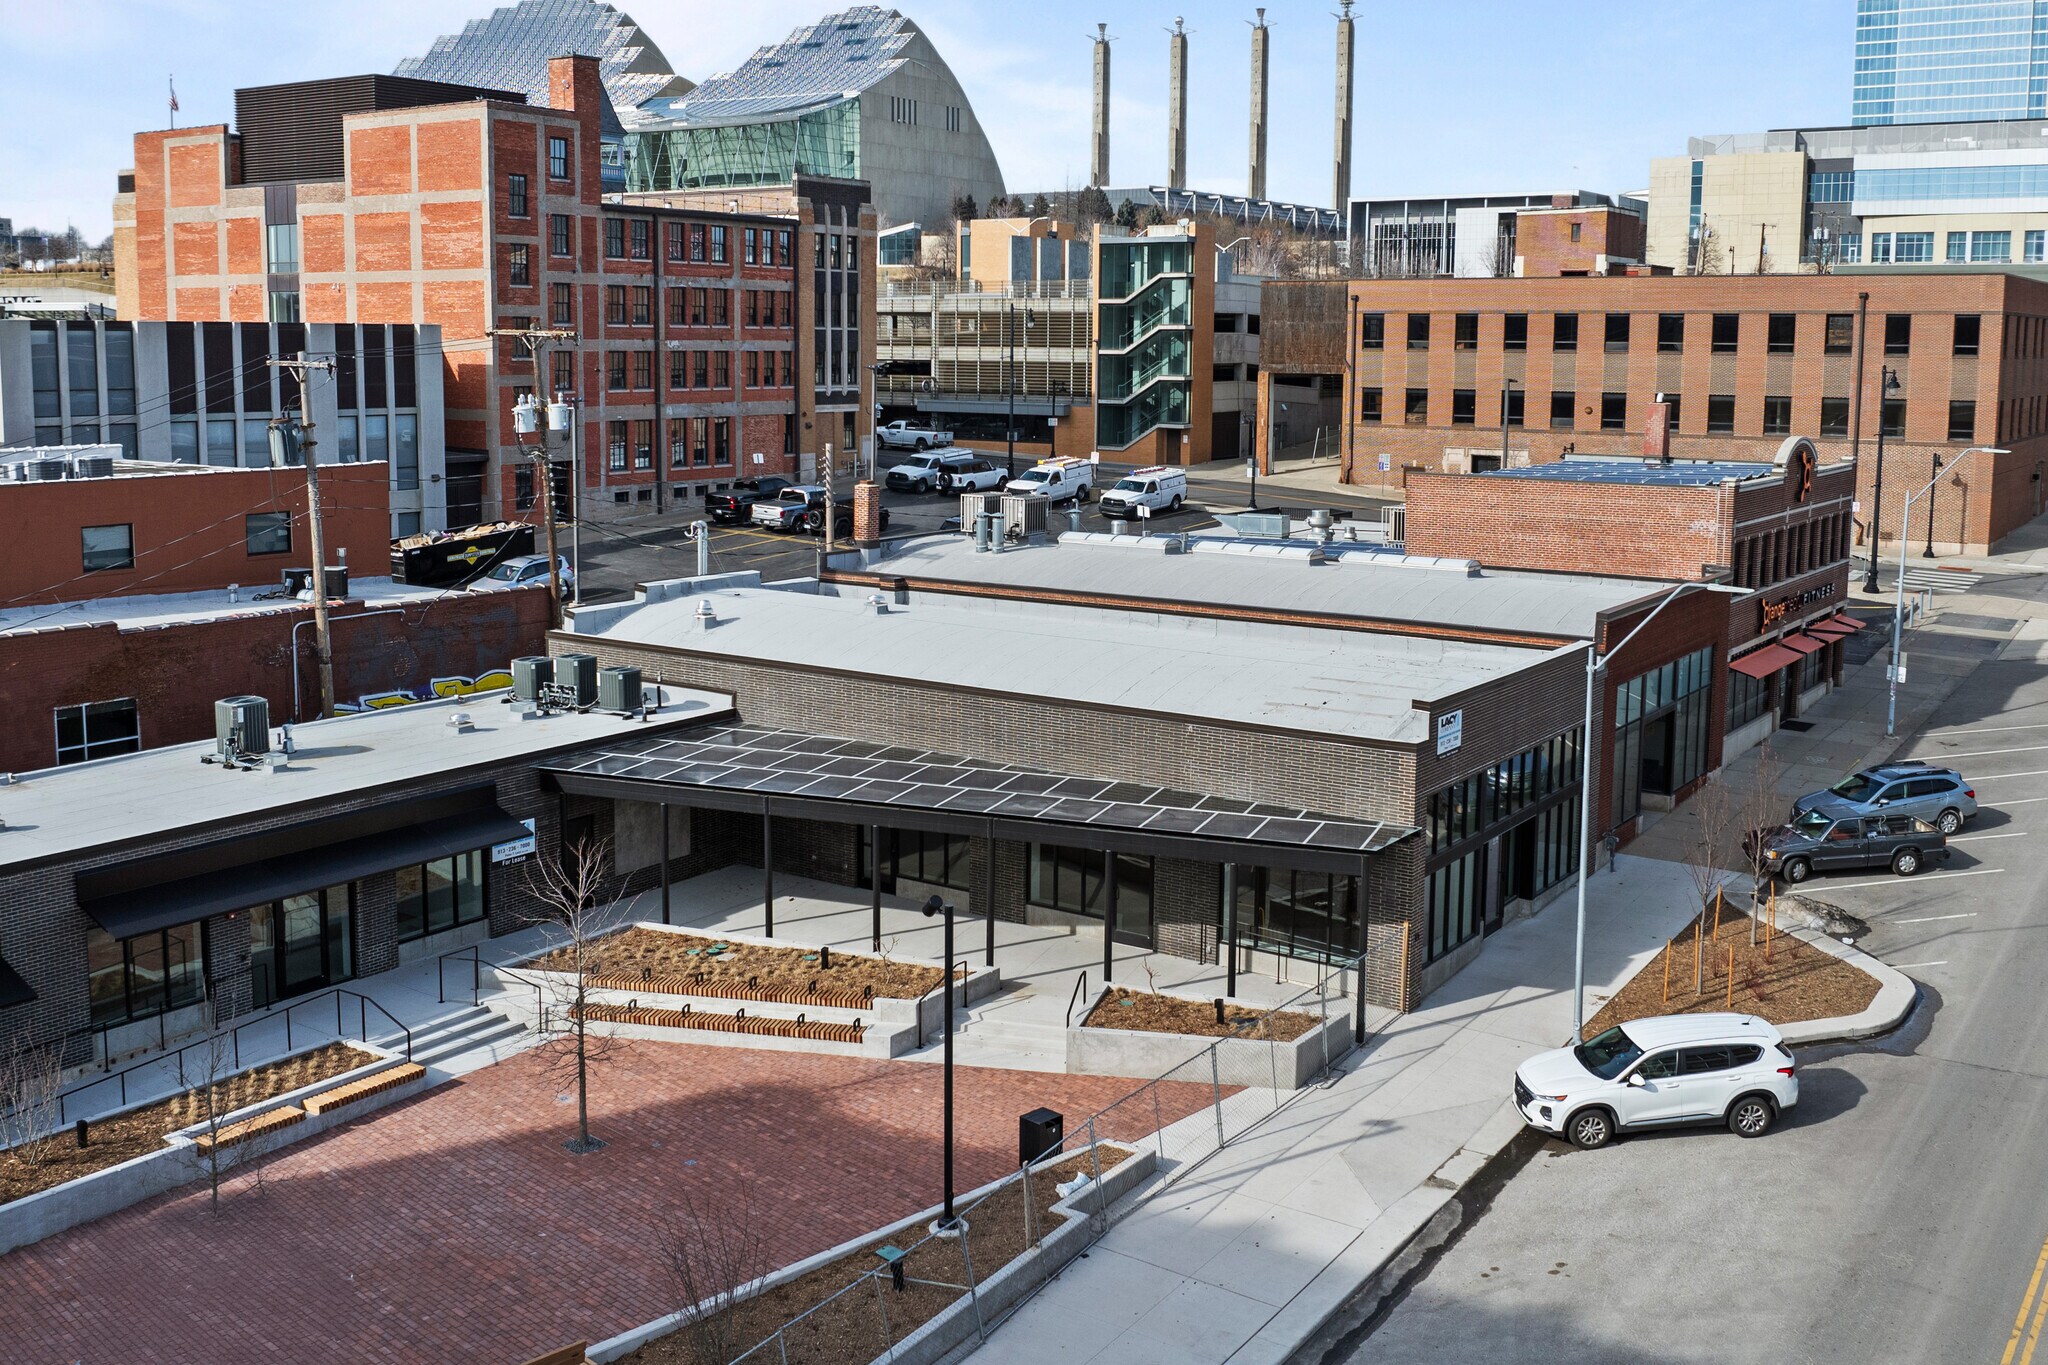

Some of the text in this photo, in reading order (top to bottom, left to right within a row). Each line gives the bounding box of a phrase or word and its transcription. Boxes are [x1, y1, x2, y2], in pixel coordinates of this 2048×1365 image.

[1803, 583, 1835, 605] FITNESS
[1441, 713, 1457, 728] LACY
[511, 855, 526, 863] Lease
